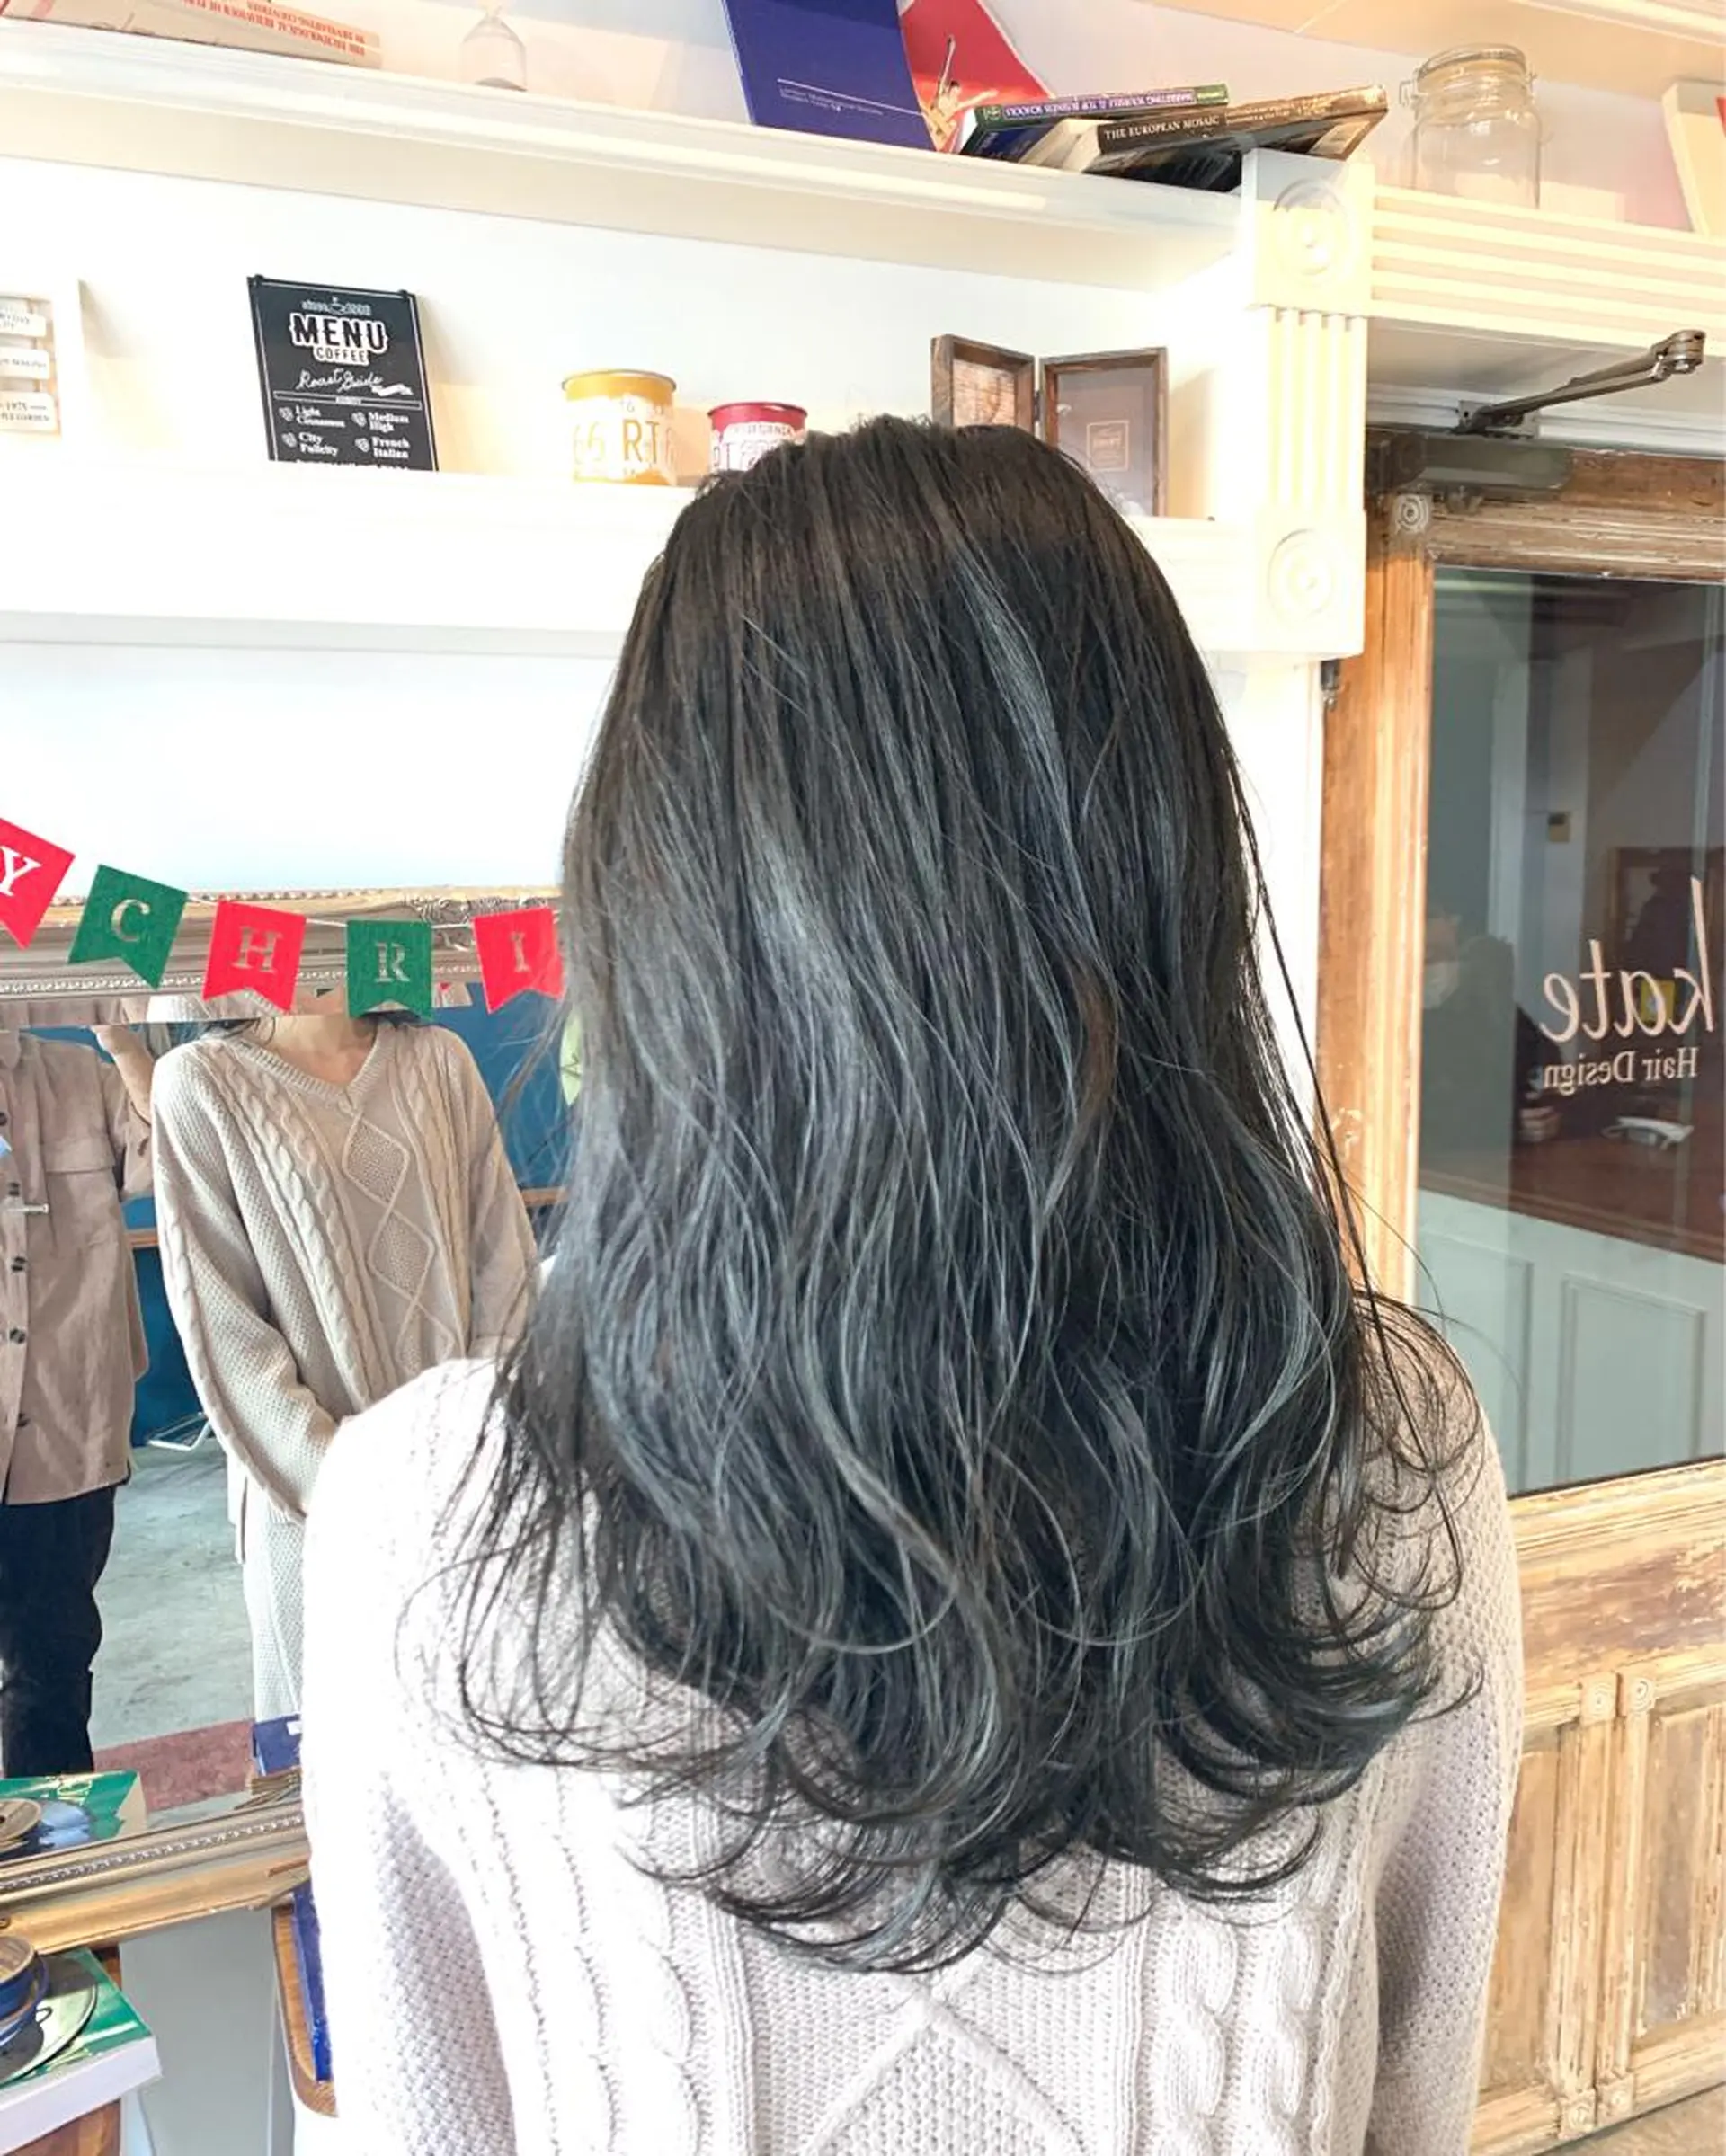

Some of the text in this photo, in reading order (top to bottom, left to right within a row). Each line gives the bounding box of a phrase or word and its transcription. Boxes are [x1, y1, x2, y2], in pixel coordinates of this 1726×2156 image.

[1104, 115, 1220, 140] THE EUROPEAN MOSAIC
[291, 314, 387, 350] MENU
[316, 346, 367, 363] COFFEE
[295, 368, 344, 390] Roast
[298, 431, 324, 445] City
[371, 436, 411, 449] French
[373, 447, 410, 459] Italian
[0, 845, 43, 898] Y
